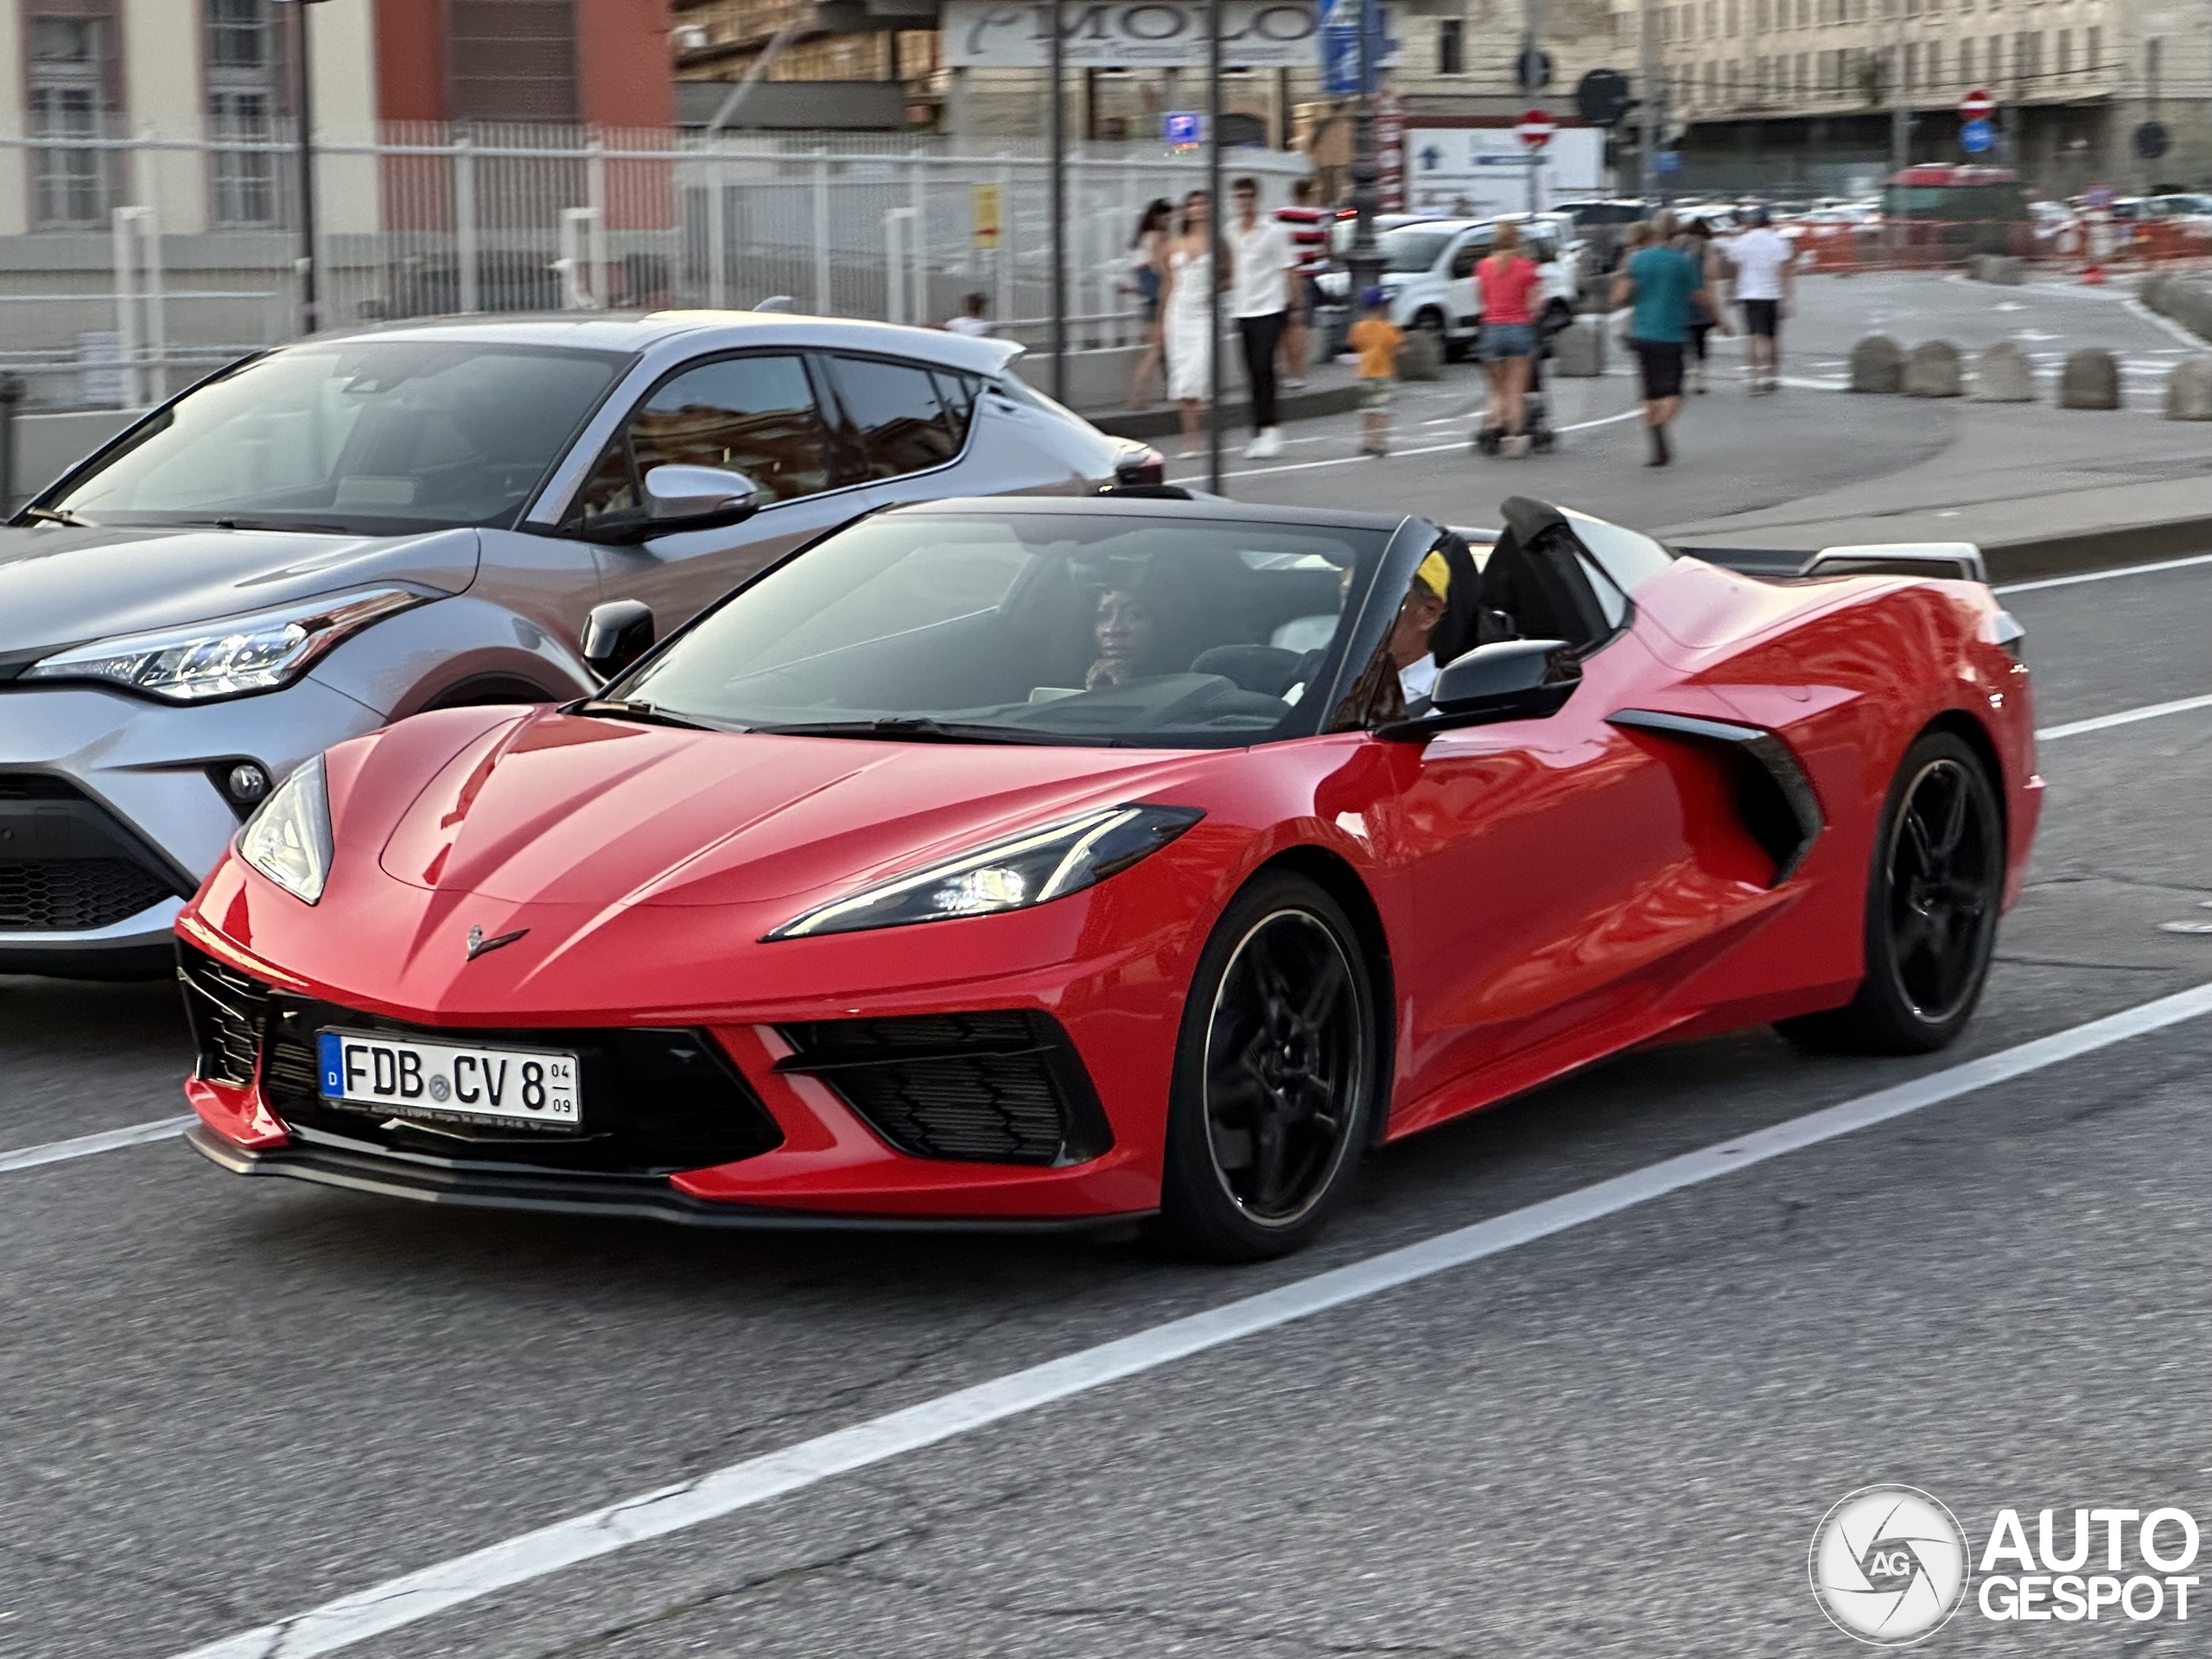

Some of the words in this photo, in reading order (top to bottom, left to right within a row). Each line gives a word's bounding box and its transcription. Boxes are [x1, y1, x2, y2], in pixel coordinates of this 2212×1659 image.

[345, 1045, 424, 1098] FDB
[454, 1055, 507, 1106] CV
[522, 1061, 546, 1109] 8
[551, 1063, 570, 1078] 04
[327, 1071, 337, 1086] D
[553, 1098, 571, 1114] 09
